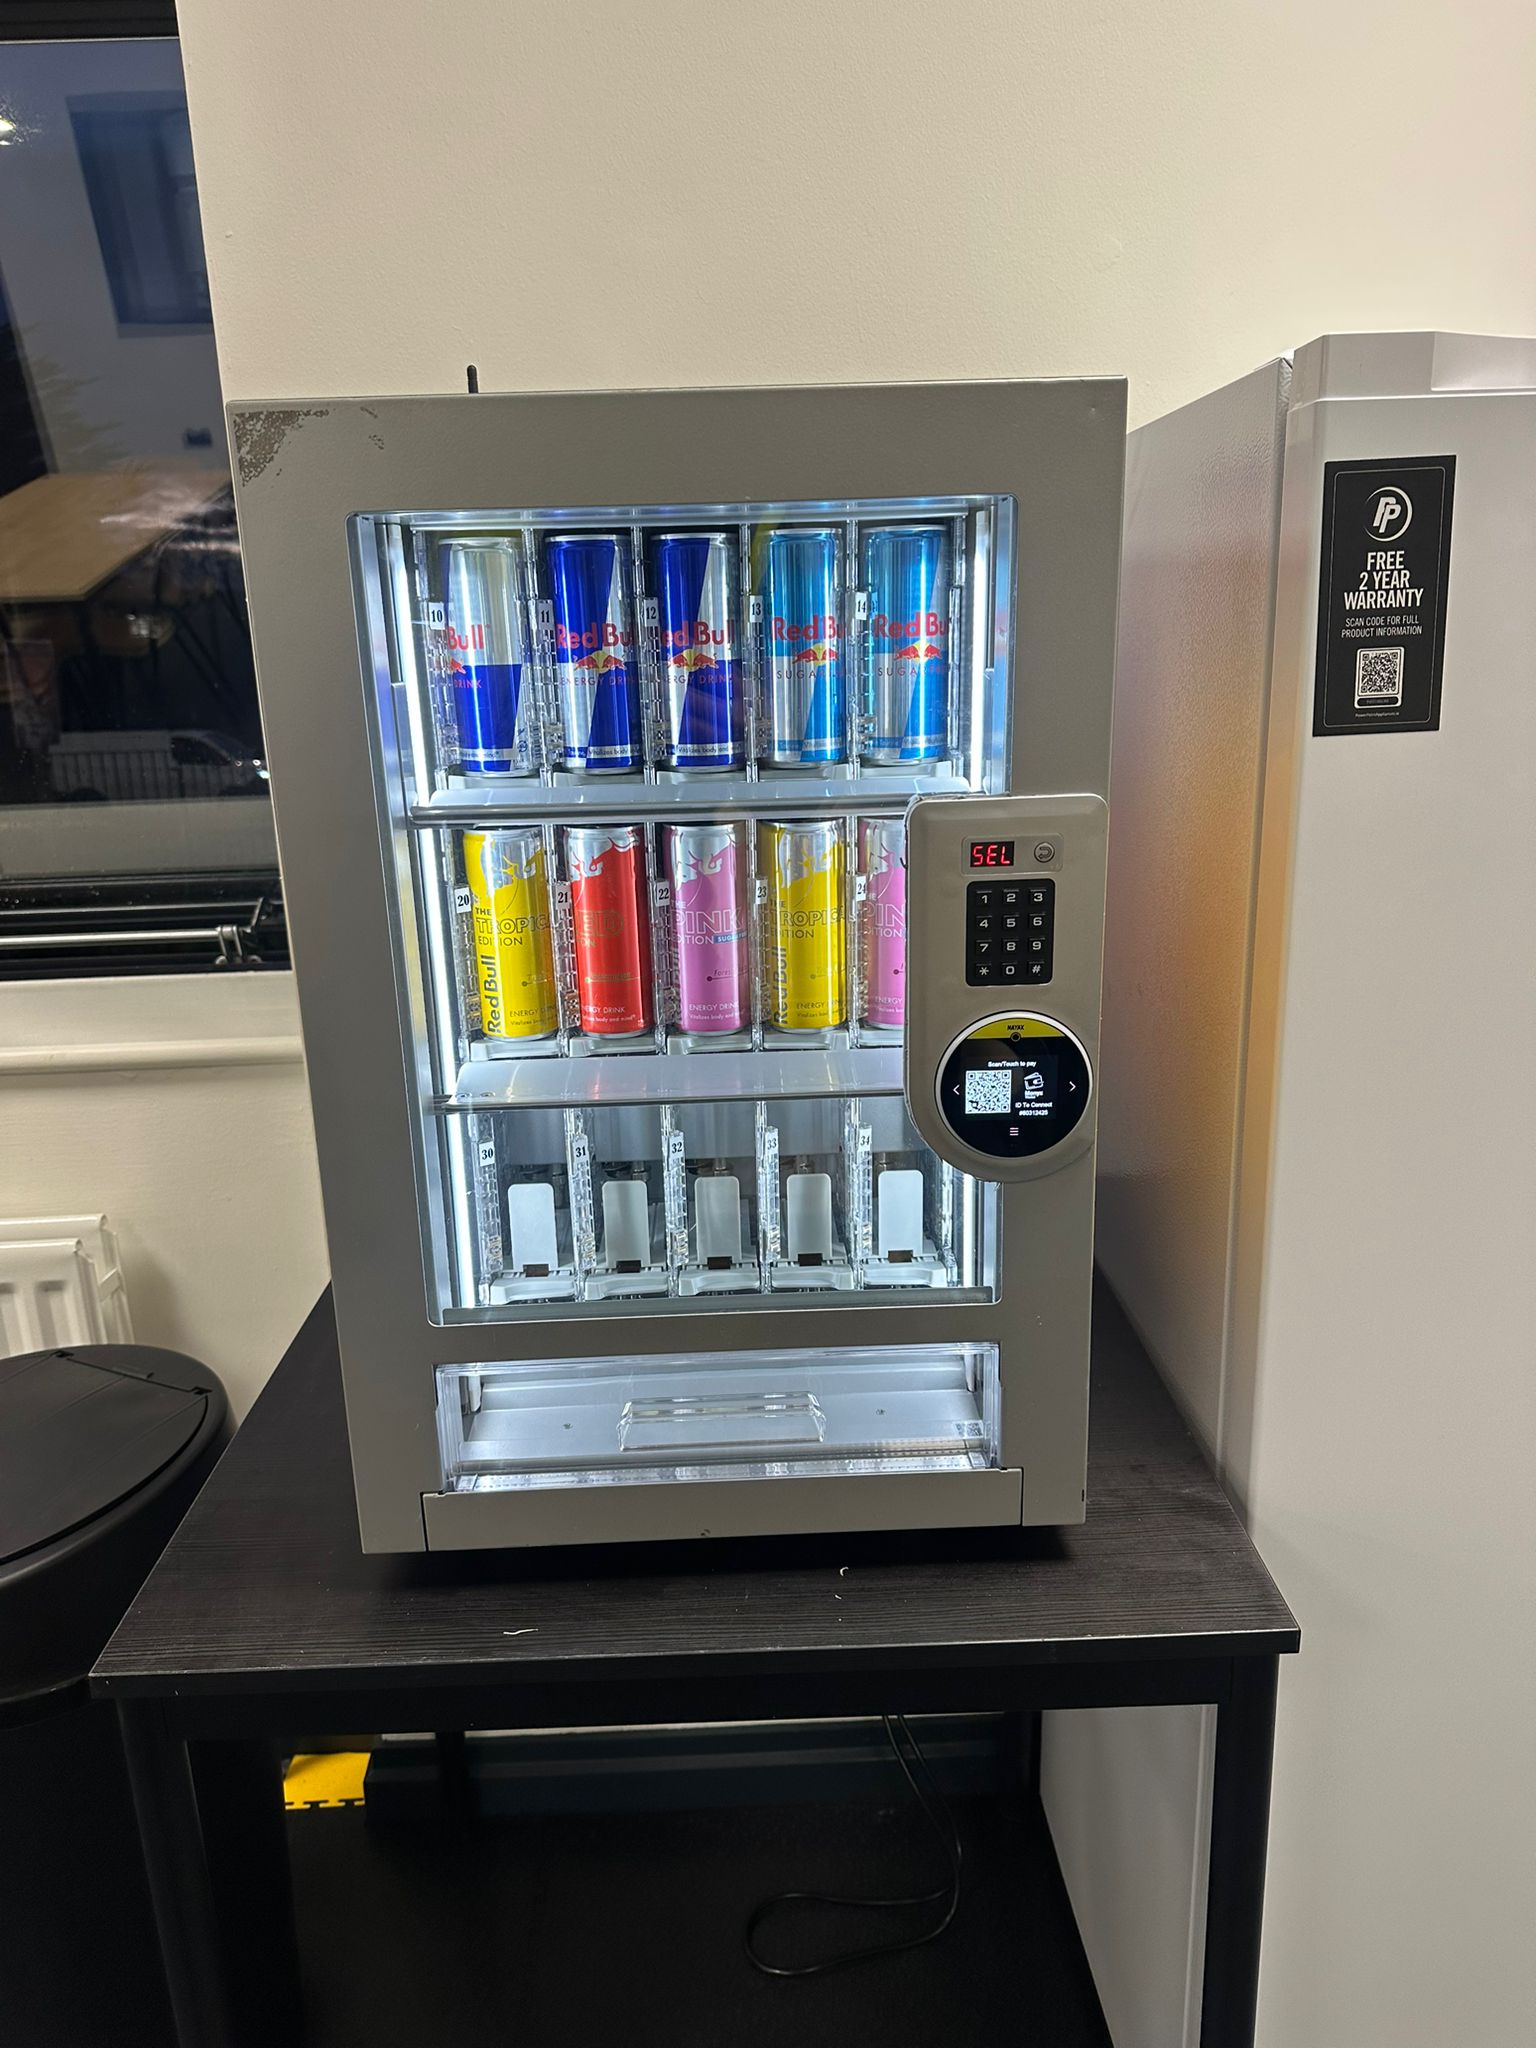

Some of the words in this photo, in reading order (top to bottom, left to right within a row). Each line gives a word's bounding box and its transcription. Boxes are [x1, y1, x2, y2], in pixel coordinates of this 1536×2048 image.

[1367, 550, 1405, 571] FREE
[1359, 571, 1369, 590] 2
[1373, 570, 1410, 590] YEAR
[1344, 588, 1424, 610] WARRANTY
[645, 606, 657, 620] 12
[752, 602, 762, 616] 13
[857, 601, 867, 614] 14
[431, 609, 443, 623] 10
[541, 610, 550, 623] 11
[1345, 617, 1364, 627] SCAN
[1366, 616, 1385, 626] CODE
[1387, 615, 1401, 625] FOR
[1402, 614, 1419, 624] FULL
[771, 614, 819, 642] Red
[824, 615, 846, 641] Bu
[874, 611, 921, 639] Red
[925, 611, 948, 637] Bu
[1341, 627, 1374, 638] PRODUCT
[1376, 625, 1422, 637] INFORMATION
[447, 624, 485, 651] Bull
[554, 622, 598, 650] Red
[602, 622, 635, 648] Bu
[661, 620, 689, 648] ed
[693, 619, 735, 646] Bull
[973, 845, 1010, 866] SEL
[557, 891, 568, 903] 21
[658, 888, 669, 900] 22
[757, 886, 767, 898] 23
[981, 894, 988, 904] 1
[1006, 893, 1016, 903] 2
[1034, 892, 1043, 902] 3
[457, 894, 470, 907] 20
[861, 902, 905, 927] PIN
[476, 914, 550, 935] TROPIC
[980, 919, 989, 929] 4
[1006, 918, 1016, 928] 5
[1033, 917, 1042, 926] 6
[980, 943, 988, 953] 7
[1006, 942, 1016, 951] 8
[1032, 940, 1042, 950] 9
[481, 955, 498, 992] Bull
[1005, 966, 1015, 975] 0
[1032, 964, 1041, 974] #
[487, 995, 501, 1033] Red
[510, 1008, 540, 1017] ENERGY
[768, 1138, 777, 1149] 33
[860, 1136, 870, 1145] 34
[482, 1148, 494, 1160] 30
[576, 1146, 586, 1157] 31
[672, 1142, 683, 1153] 32
